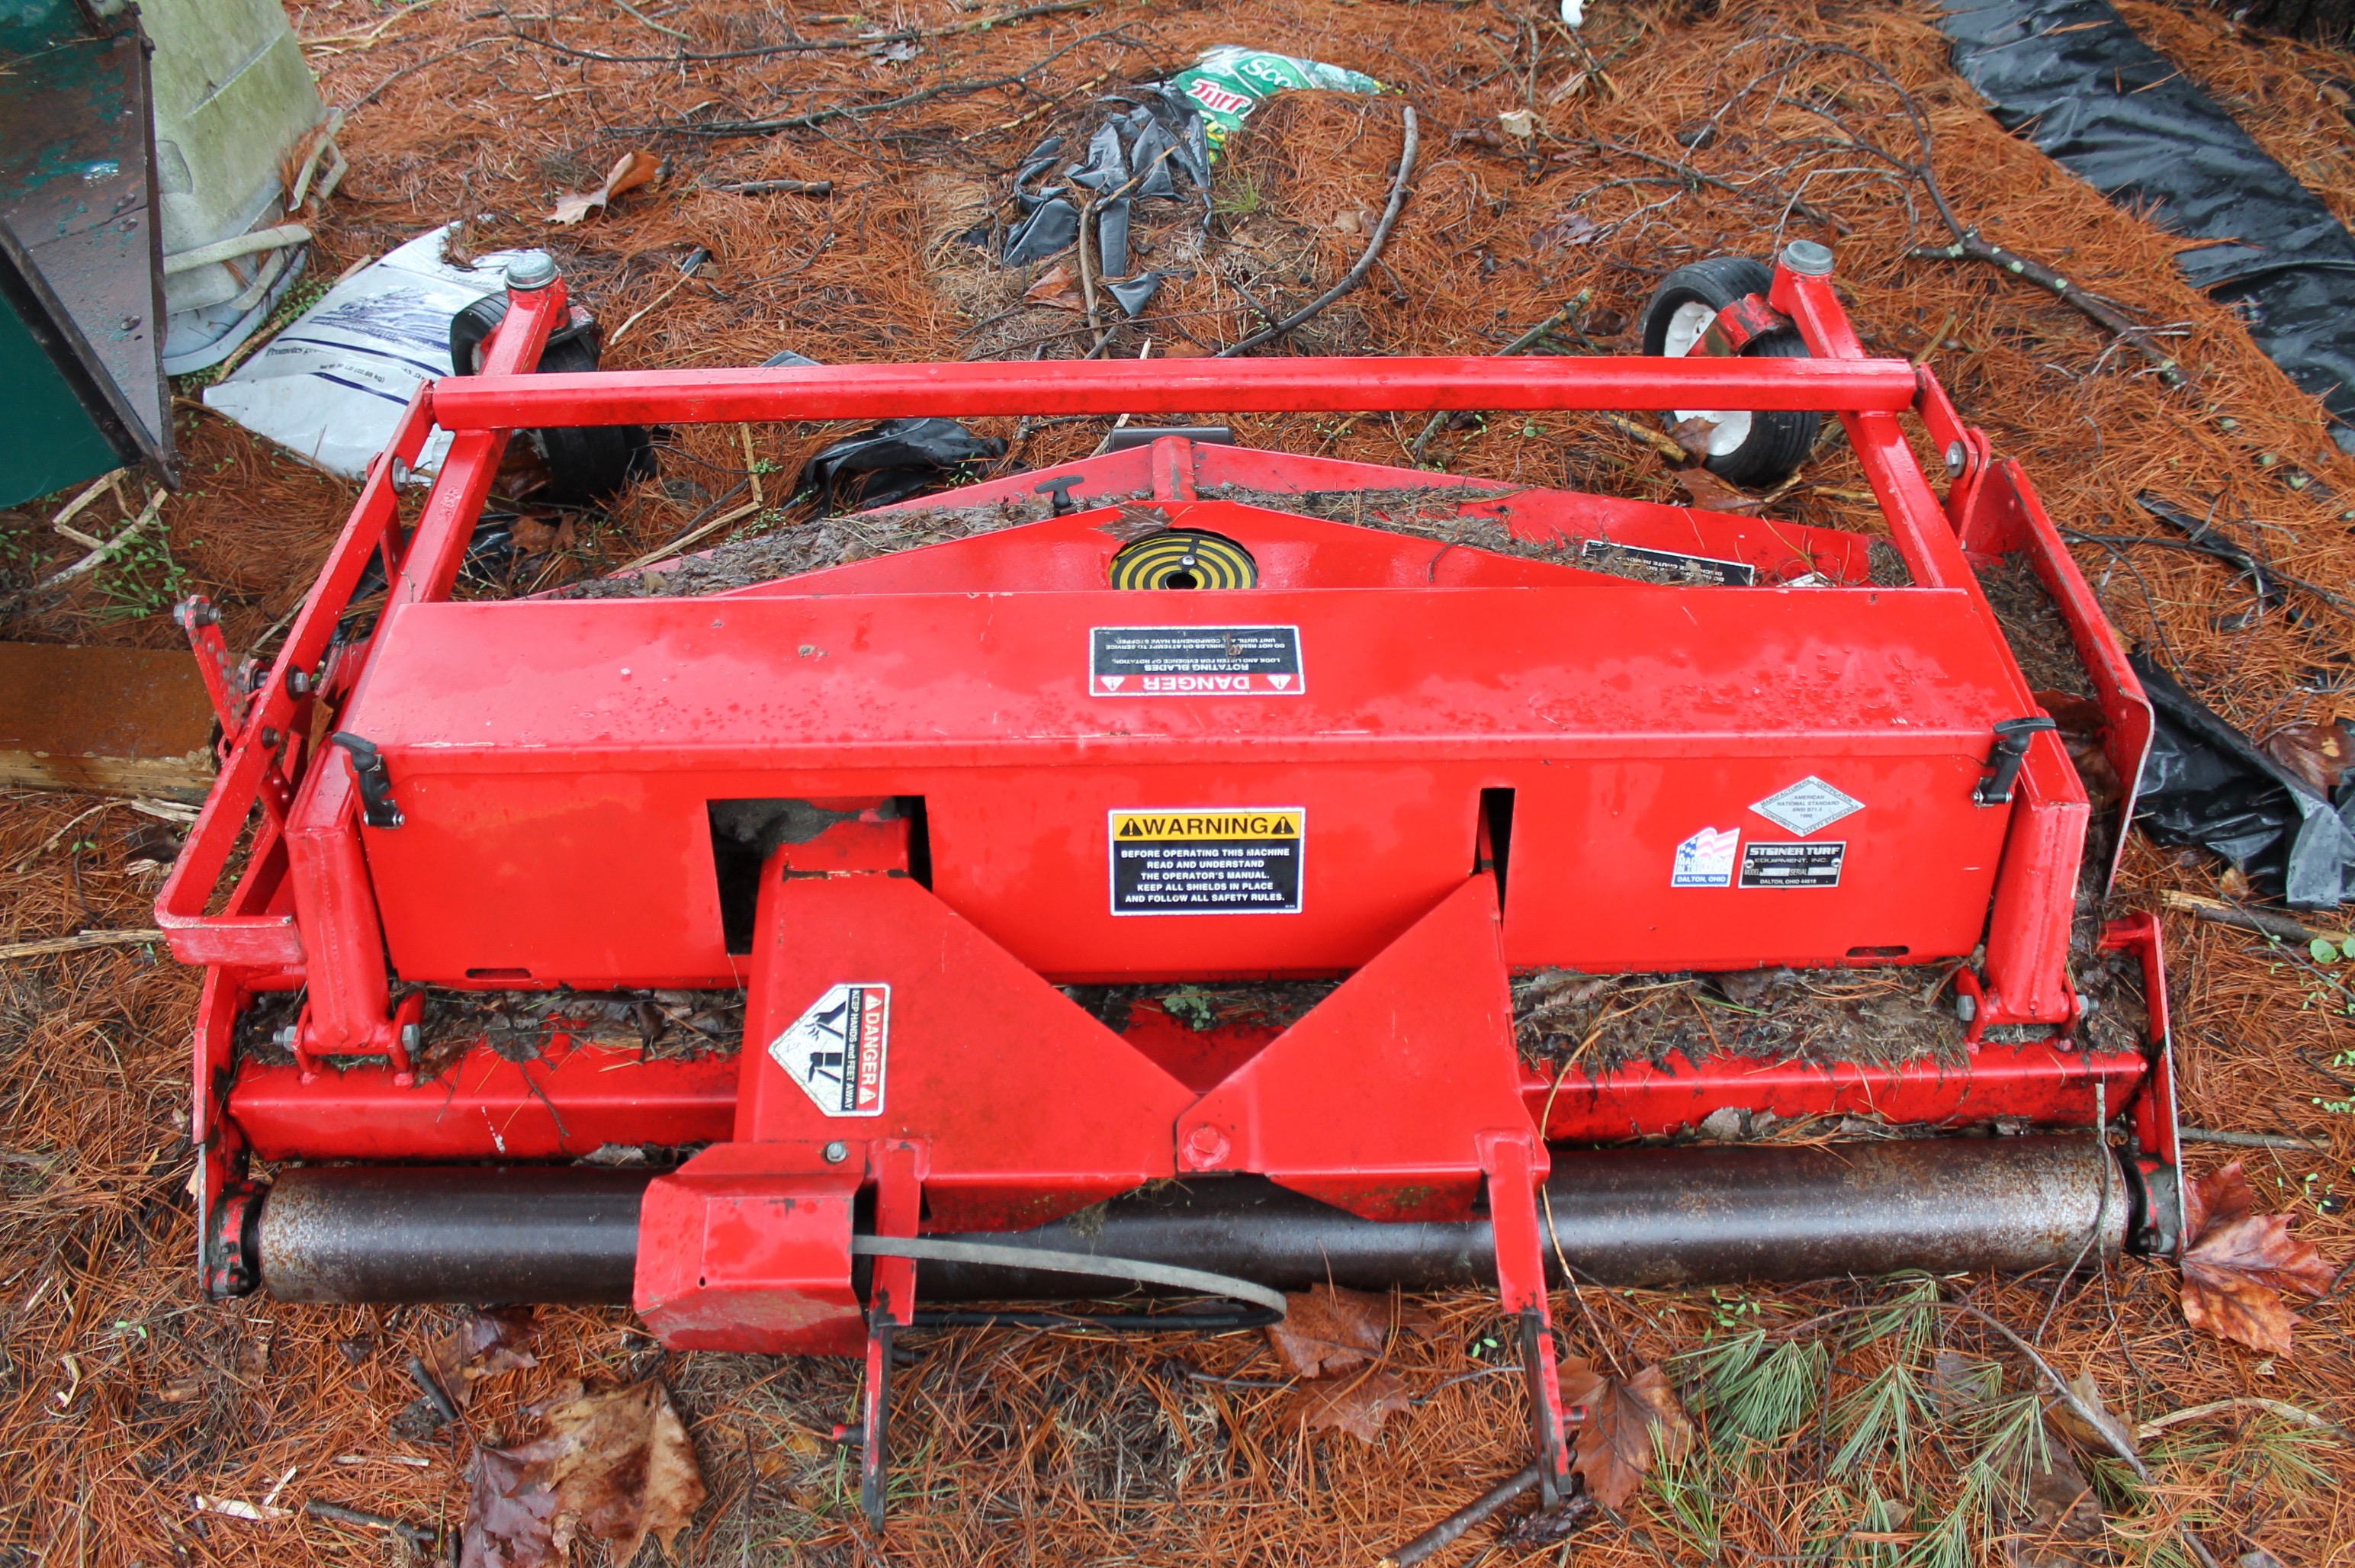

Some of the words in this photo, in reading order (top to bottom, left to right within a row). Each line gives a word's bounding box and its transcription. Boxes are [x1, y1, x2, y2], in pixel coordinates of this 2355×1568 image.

[1187, 79, 1251, 114] Turf
[265, 347, 303, 357] Promotes
[374, 374, 385, 384] kg)
[1142, 676, 1250, 690] DANGER
[1817, 781, 1852, 803] CERTIFICATION
[1142, 818, 1269, 835] WARNING
[1763, 811, 1791, 829] CONFORMS
[1802, 822, 1823, 835] SAFETY
[1825, 805, 1859, 824] STANDARDS
[1121, 850, 1161, 858] BEFORE
[1163, 850, 1219, 858] OPERATING
[1222, 849, 1244, 857] THIS
[1246, 848, 1290, 856] MACHINE
[1749, 847, 1804, 856] STEINER
[1806, 847, 1840, 855] TURF
[1677, 856, 1702, 865] MADE
[1702, 856, 1730, 872] USA
[1162, 872, 1224, 880] OPERATOR'S
[1227, 871, 1270, 879] MANUAL.
[1148, 895, 1187, 903] FOLLOW
[1190, 894, 1209, 902] ALL
[1211, 894, 1248, 902] SAFETY
[1251, 893, 1285, 901] RULES.
[851, 990, 861, 1012] KEEP
[849, 1013, 859, 1043] HANDS
[847, 1044, 856, 1060] and
[861, 1012, 880, 1086] DANGER
[846, 1060, 856, 1081] FEET
[844, 1082, 855, 1110] AWAY
